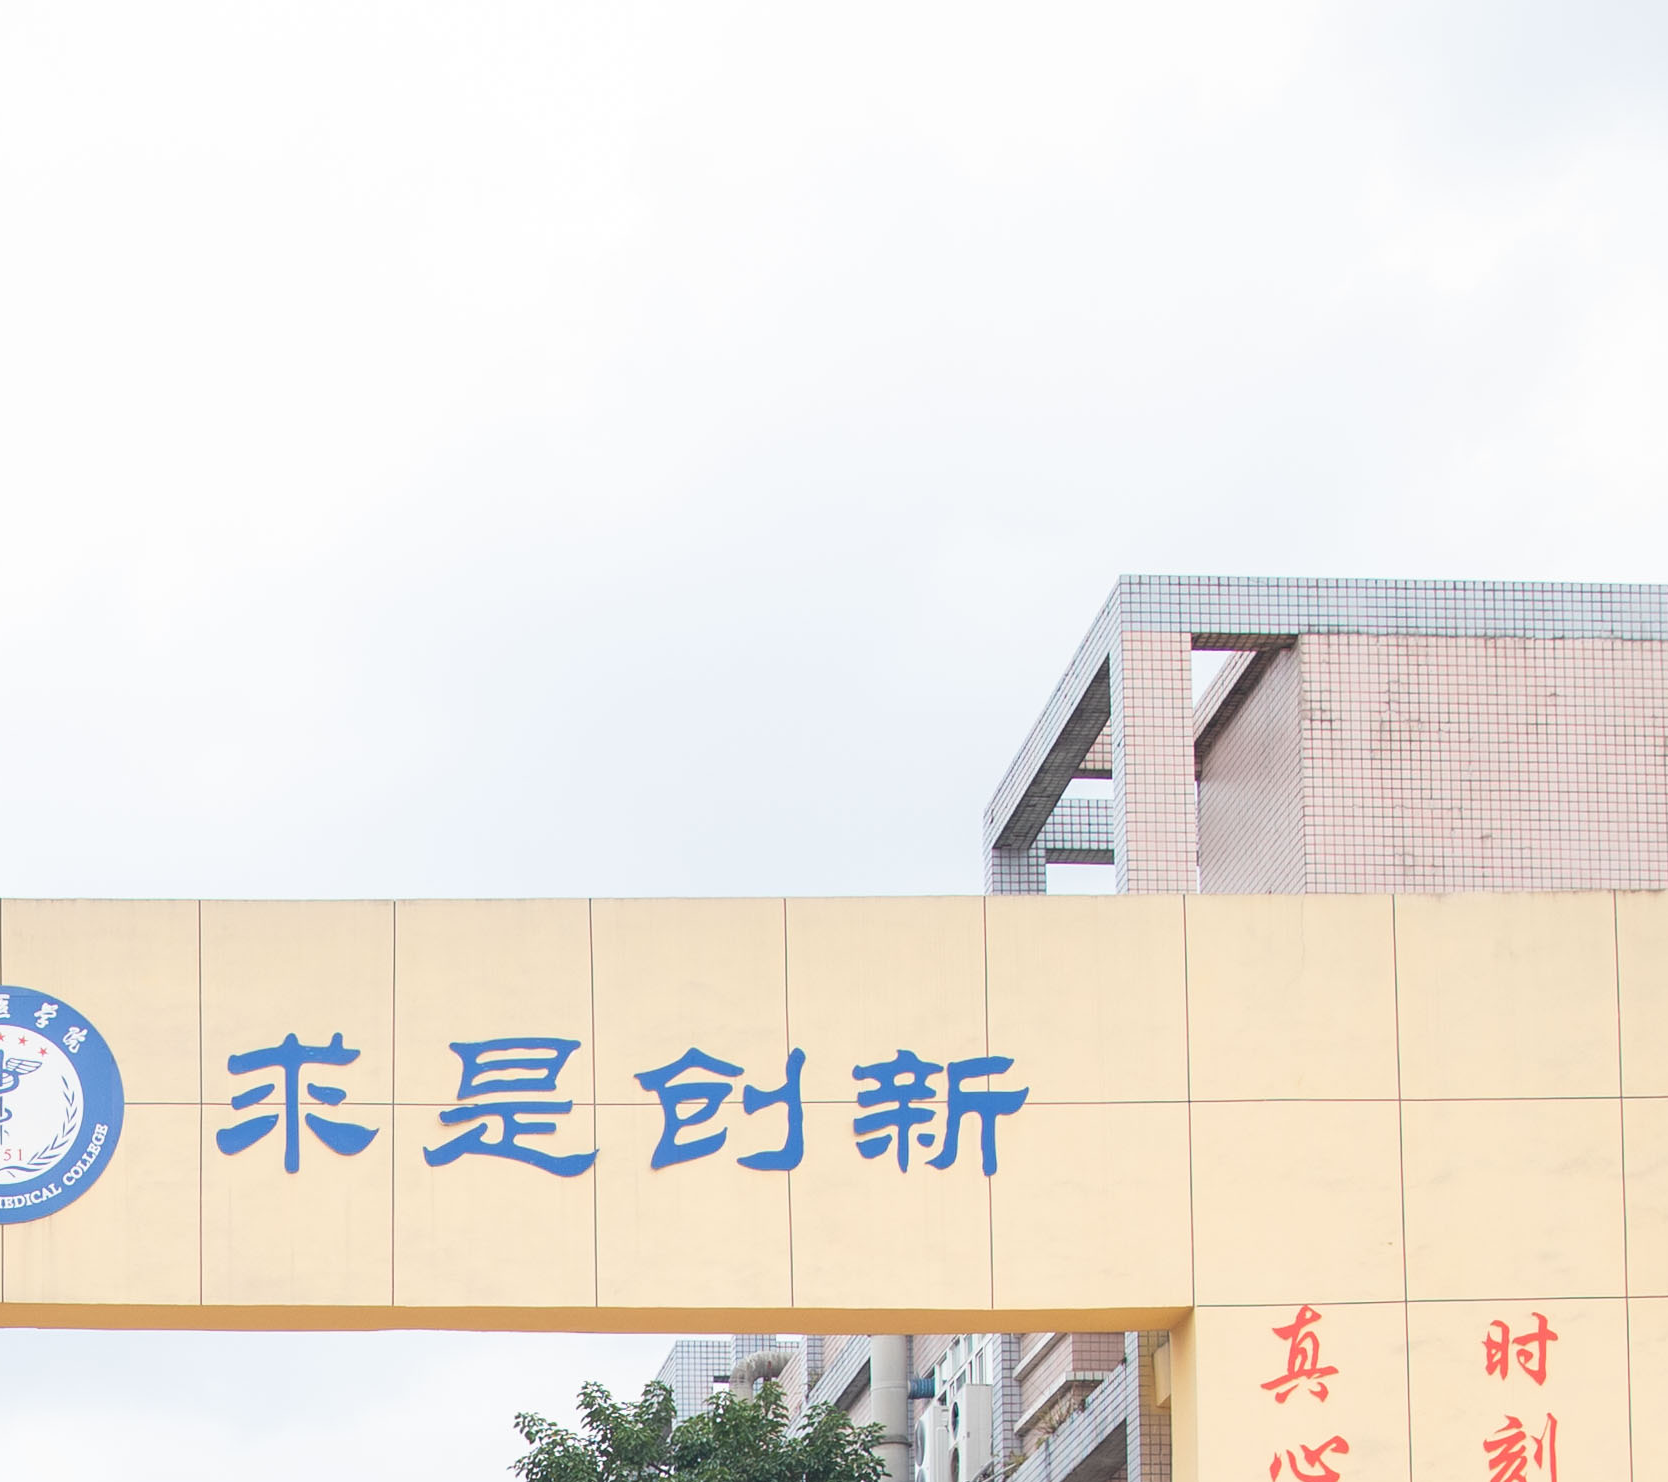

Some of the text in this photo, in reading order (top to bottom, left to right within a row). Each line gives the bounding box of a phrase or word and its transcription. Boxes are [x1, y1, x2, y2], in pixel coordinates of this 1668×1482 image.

[62, 1122, 109, 1187] COLLEGE
[216, 1032, 1029, 1177] 求是创新
